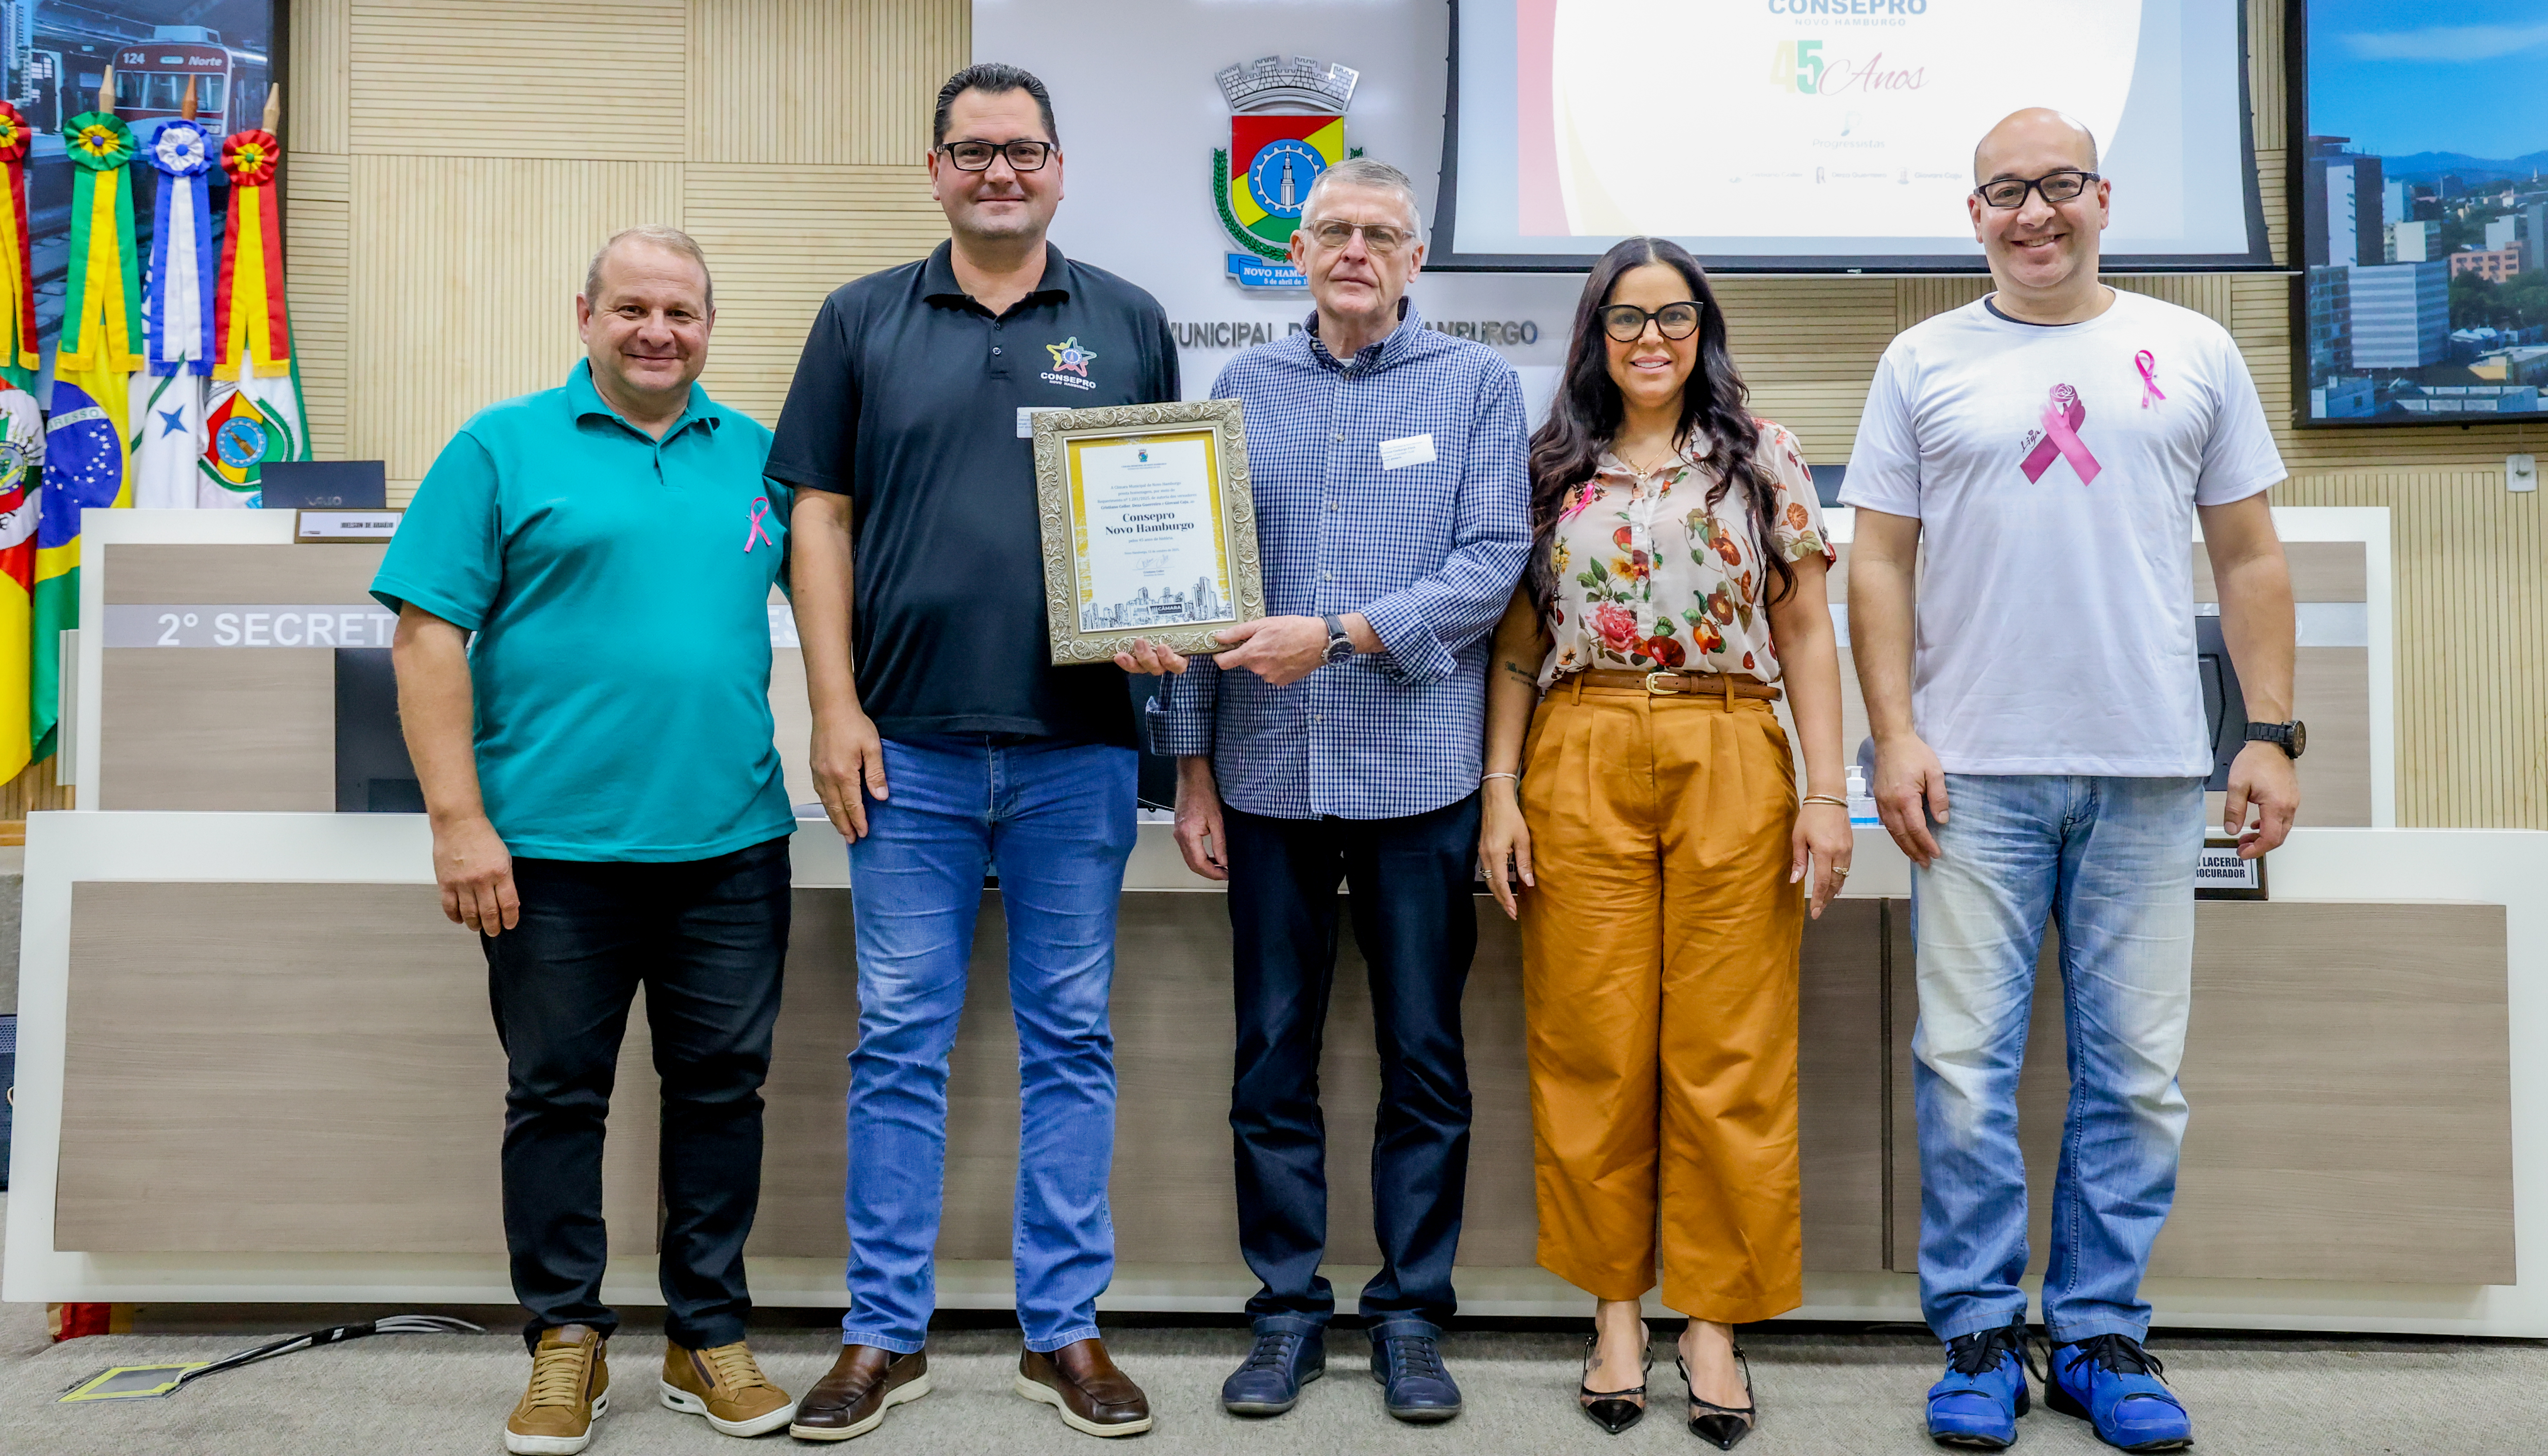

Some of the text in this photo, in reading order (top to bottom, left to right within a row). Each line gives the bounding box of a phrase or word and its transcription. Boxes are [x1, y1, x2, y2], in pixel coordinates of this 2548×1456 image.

[1768, 0, 1927, 14] CONSEPRO
[123, 52, 223, 66] 124 Norte
[1770, 39, 1930, 96] 45 Anos
[1813, 139, 1885, 150] Progressistas
[1243, 267, 1272, 277] NOVO
[1170, 322, 1272, 347] MUNICIPAL
[1040, 372, 1096, 389] CONSEPRO
[1064, 382, 1089, 390] HAMBURGO
[1123, 512, 1175, 522] Consepro
[1106, 522, 1194, 535] Novo Hamburgo
[214, 613, 393, 646] SECRET
[2202, 857, 2244, 867] LACERDA
